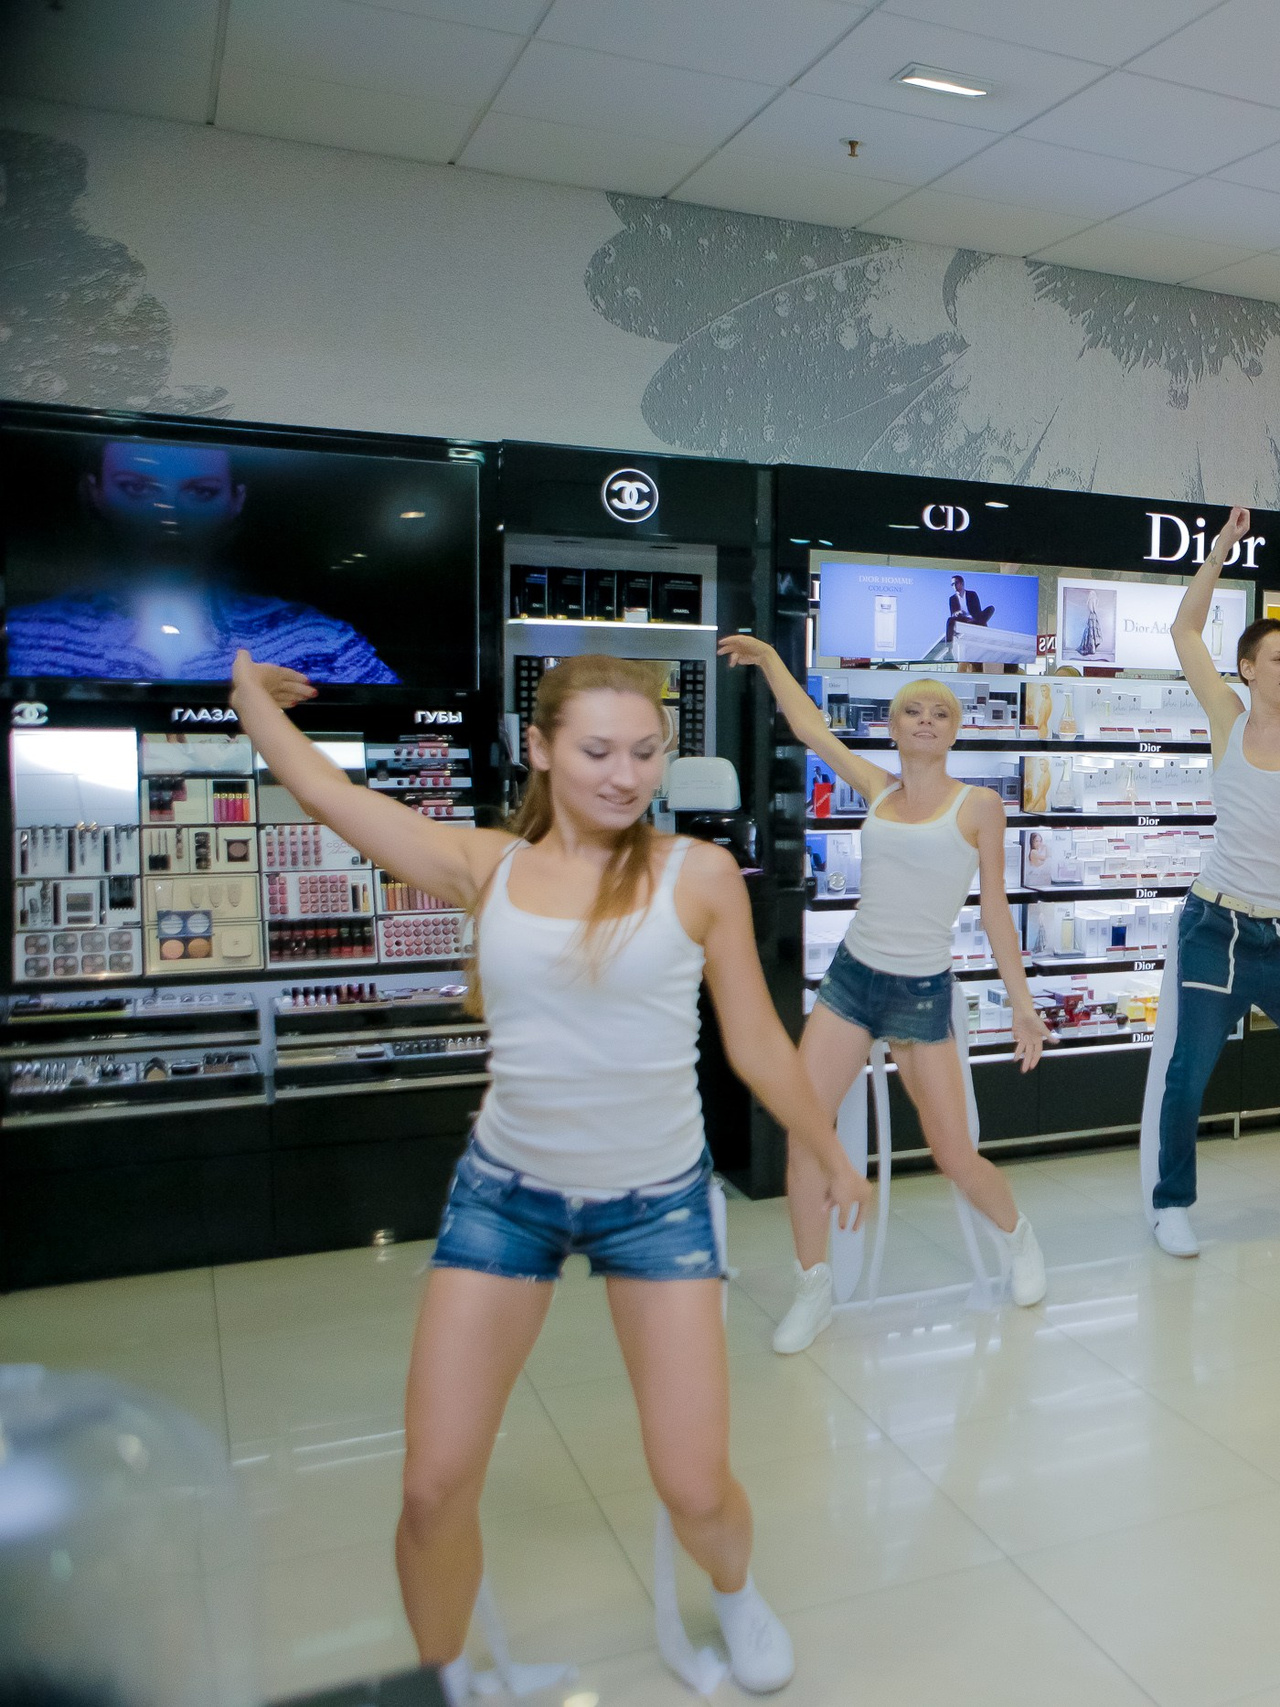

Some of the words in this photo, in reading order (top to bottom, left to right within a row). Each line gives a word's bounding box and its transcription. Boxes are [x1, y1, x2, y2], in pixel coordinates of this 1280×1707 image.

[1143, 511, 1266, 569] Dior
[1123, 619, 1149, 633] Dior
[171, 708, 239, 723] ГЛАЗА
[415, 710, 463, 724] ГУБЫ
[1139, 743, 1161, 752] Dior
[1138, 816, 1160, 826] Dior
[1136, 889, 1158, 898] Dior
[1134, 961, 1156, 971] Dior
[1132, 1033, 1154, 1042] Dior
